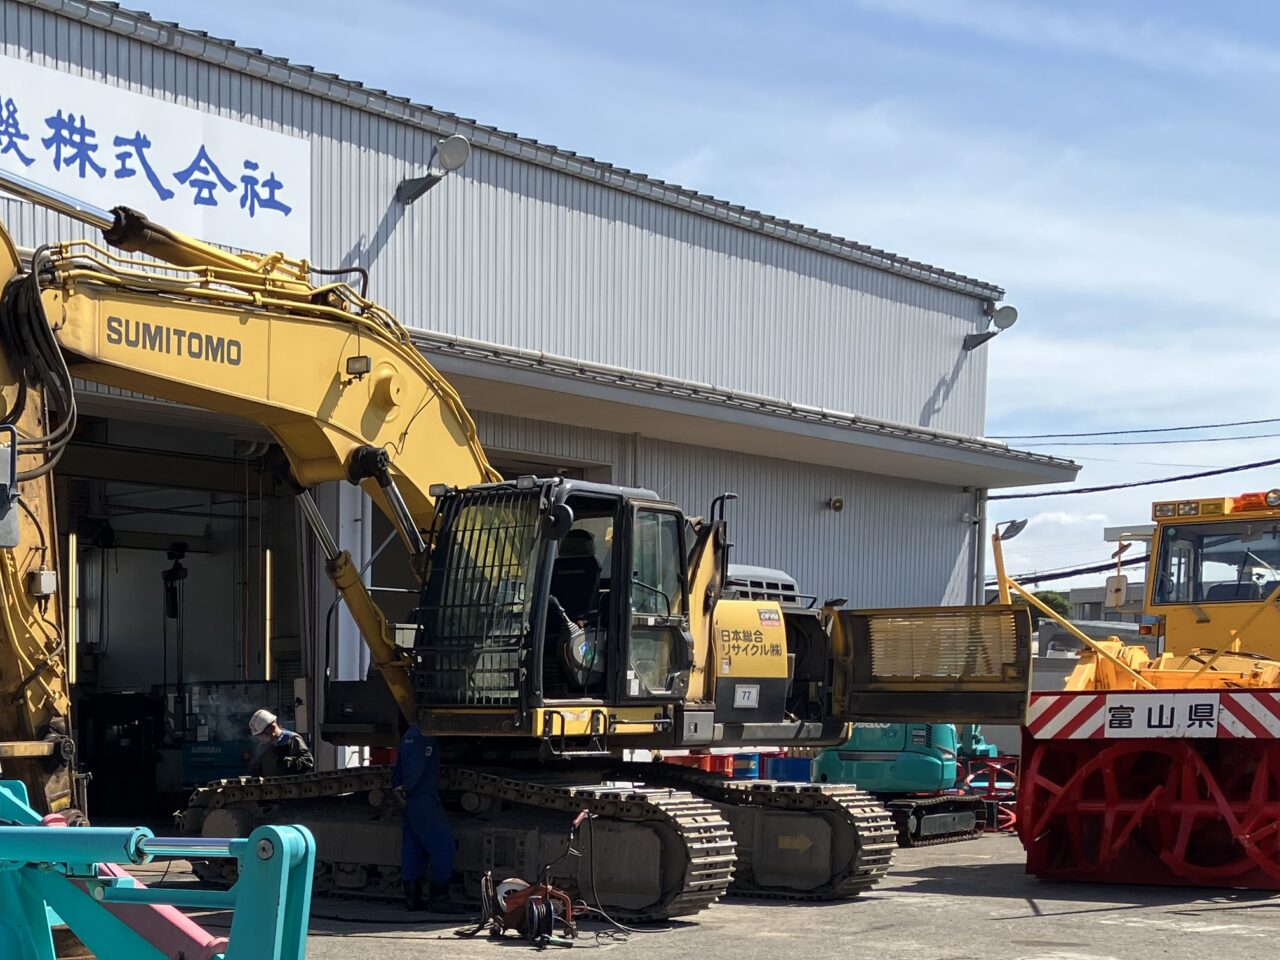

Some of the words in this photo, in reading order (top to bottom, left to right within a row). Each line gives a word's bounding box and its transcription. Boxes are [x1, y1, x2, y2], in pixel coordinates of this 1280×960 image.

[106, 315, 242, 365] SUMITOMO
[721, 629, 764, 643] 日本総合
[741, 691, 752, 701] 77
[1108, 703, 1215, 729] 富山県
